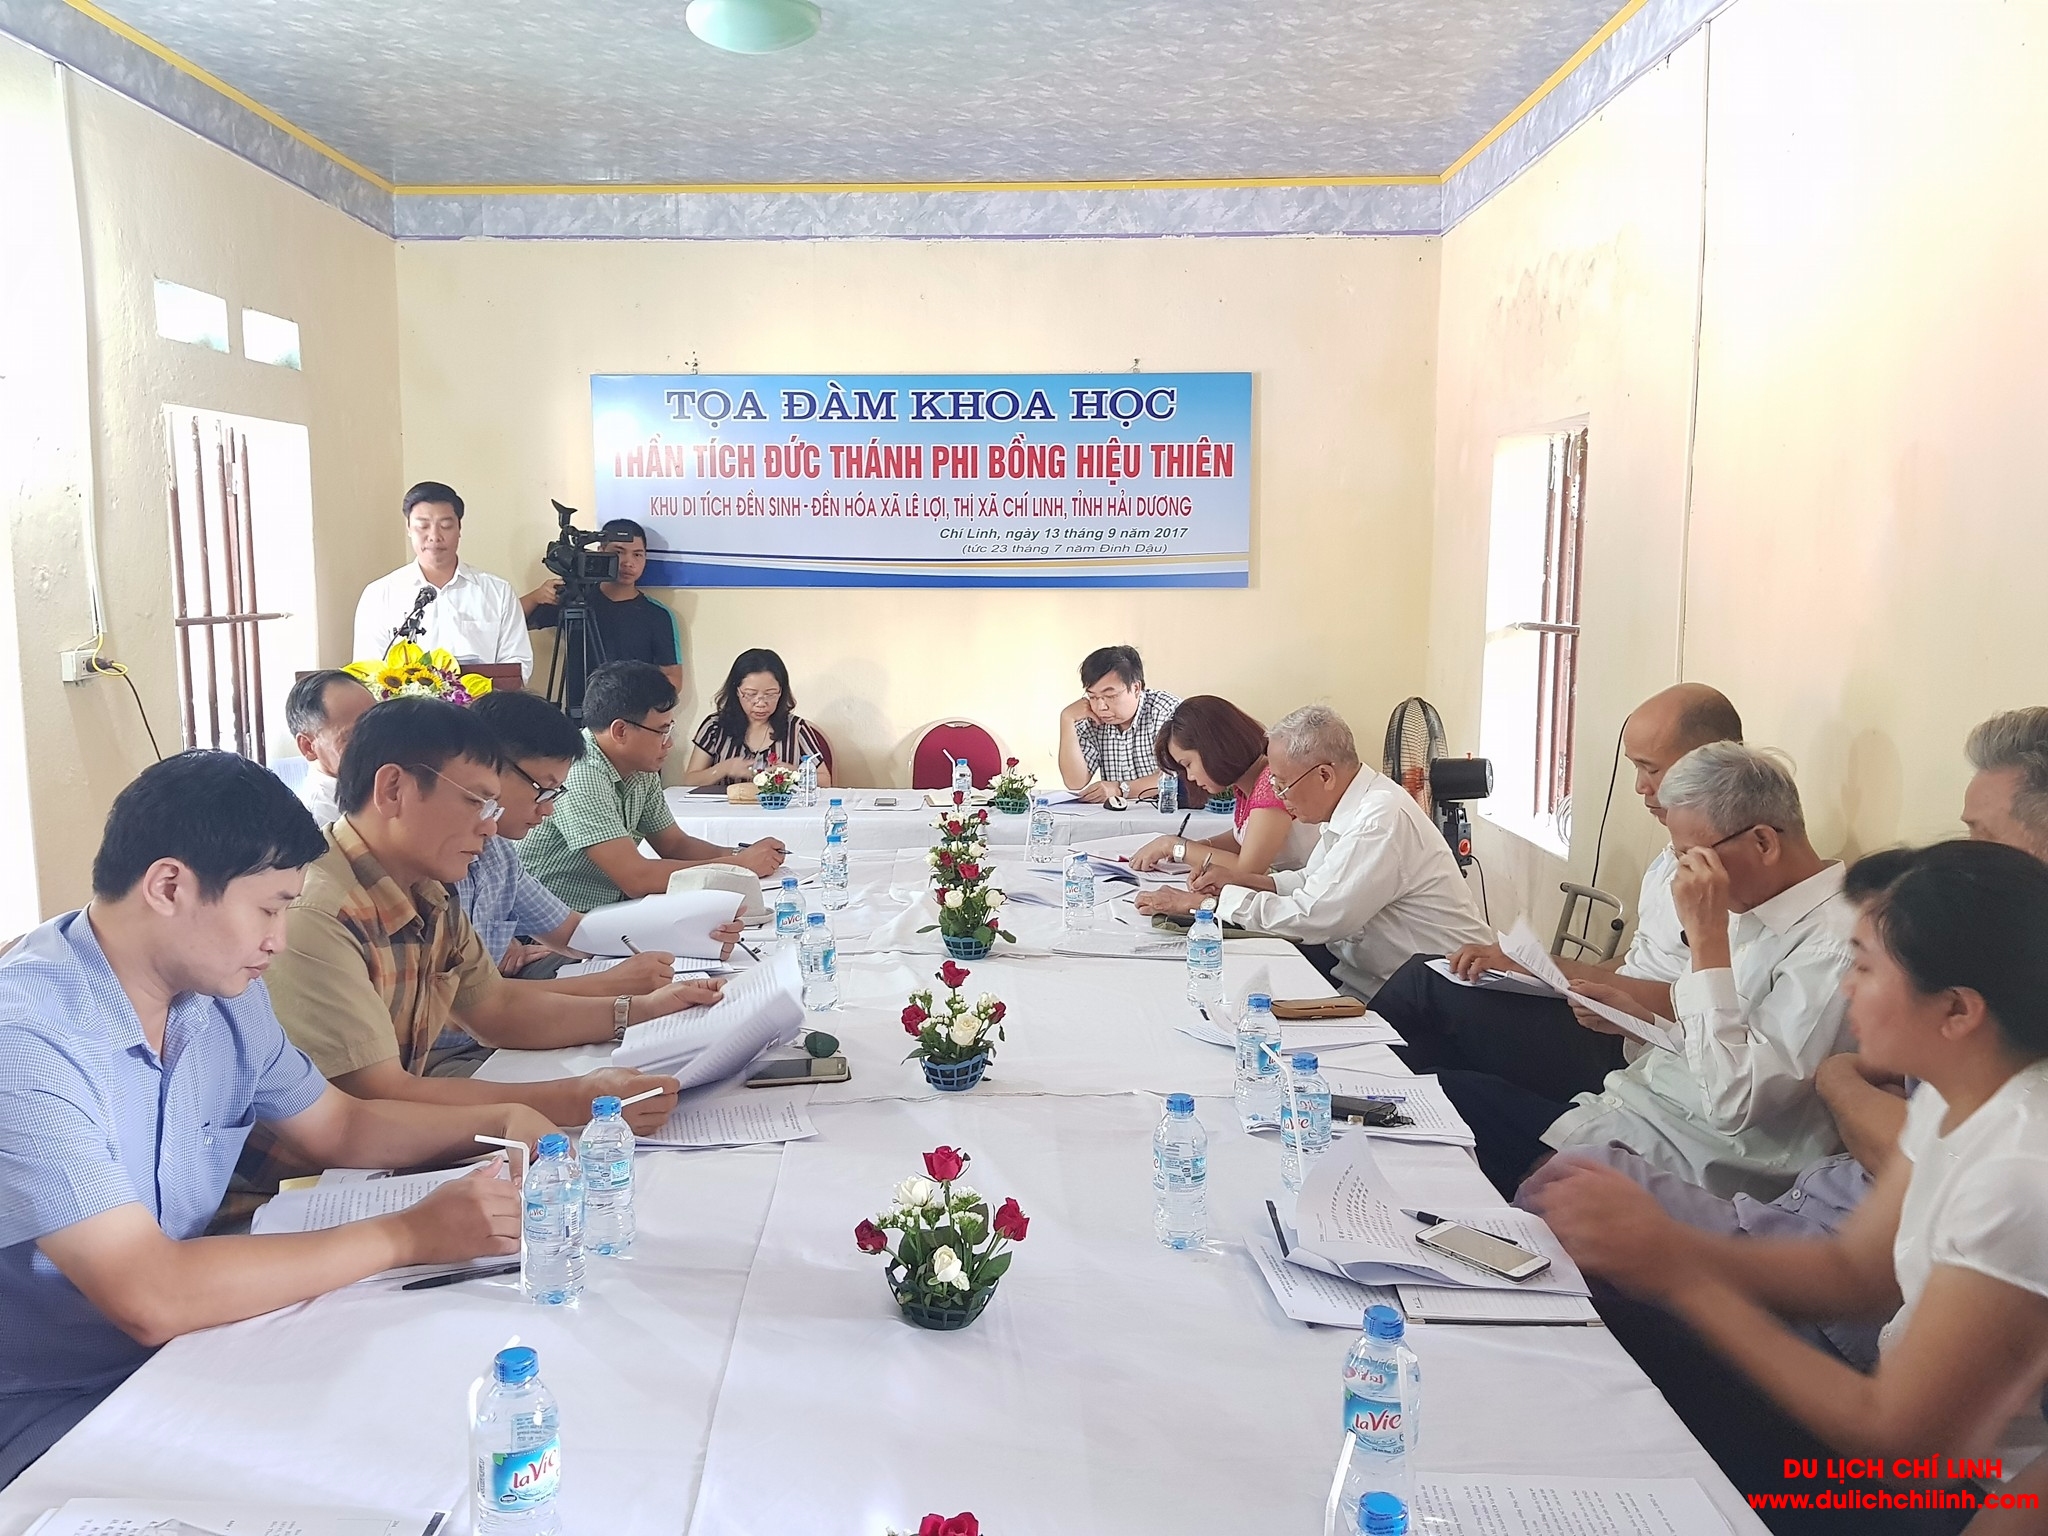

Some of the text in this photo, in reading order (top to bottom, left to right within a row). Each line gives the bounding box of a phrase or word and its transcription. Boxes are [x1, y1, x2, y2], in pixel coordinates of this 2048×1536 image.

[665, 382, 1176, 428] TỌA ĐÀM KHOA HỌC
[693, 437, 755, 479] TÍCH
[764, 435, 821, 479] ĐỨC
[830, 438, 922, 479] THÁNH
[932, 445, 978, 479] PHI
[988, 433, 1066, 479] BỒNG
[1075, 437, 1141, 486] HIỆU
[1150, 436, 1234, 478] THIÊN
[650, 496, 678, 516] KHU
[683, 496, 696, 516] DI
[701, 490, 732, 517] TÍCH
[736, 489, 765, 517] ĐỀN
[769, 497, 801, 517] SINH
[811, 489, 840, 517] ĐỀN
[845, 491, 877, 517] HÓA
[880, 493, 901, 517] XÃ
[905, 492, 919, 517] LÊ
[923, 496, 950, 521] LỢI,
[953, 494, 974, 521] THỊ
[978, 493, 999, 517] XÃ
[1003, 491, 1028, 517] CHÍ
[1032, 497, 1068, 520] LINH,
[1072, 489, 1103, 517] TỈNH
[1108, 489, 1132, 517] HẢI
[1137, 495, 1192, 517] DƯƠNG
[939, 526, 1189, 541] Chí Linh, ngày 13 tháng 9 năm 2017
[992, 545, 1007, 553] 23
[1011, 544, 1050, 556] tháng
[1054, 544, 1062, 553] 7
[1065, 544, 1095, 553] năm
